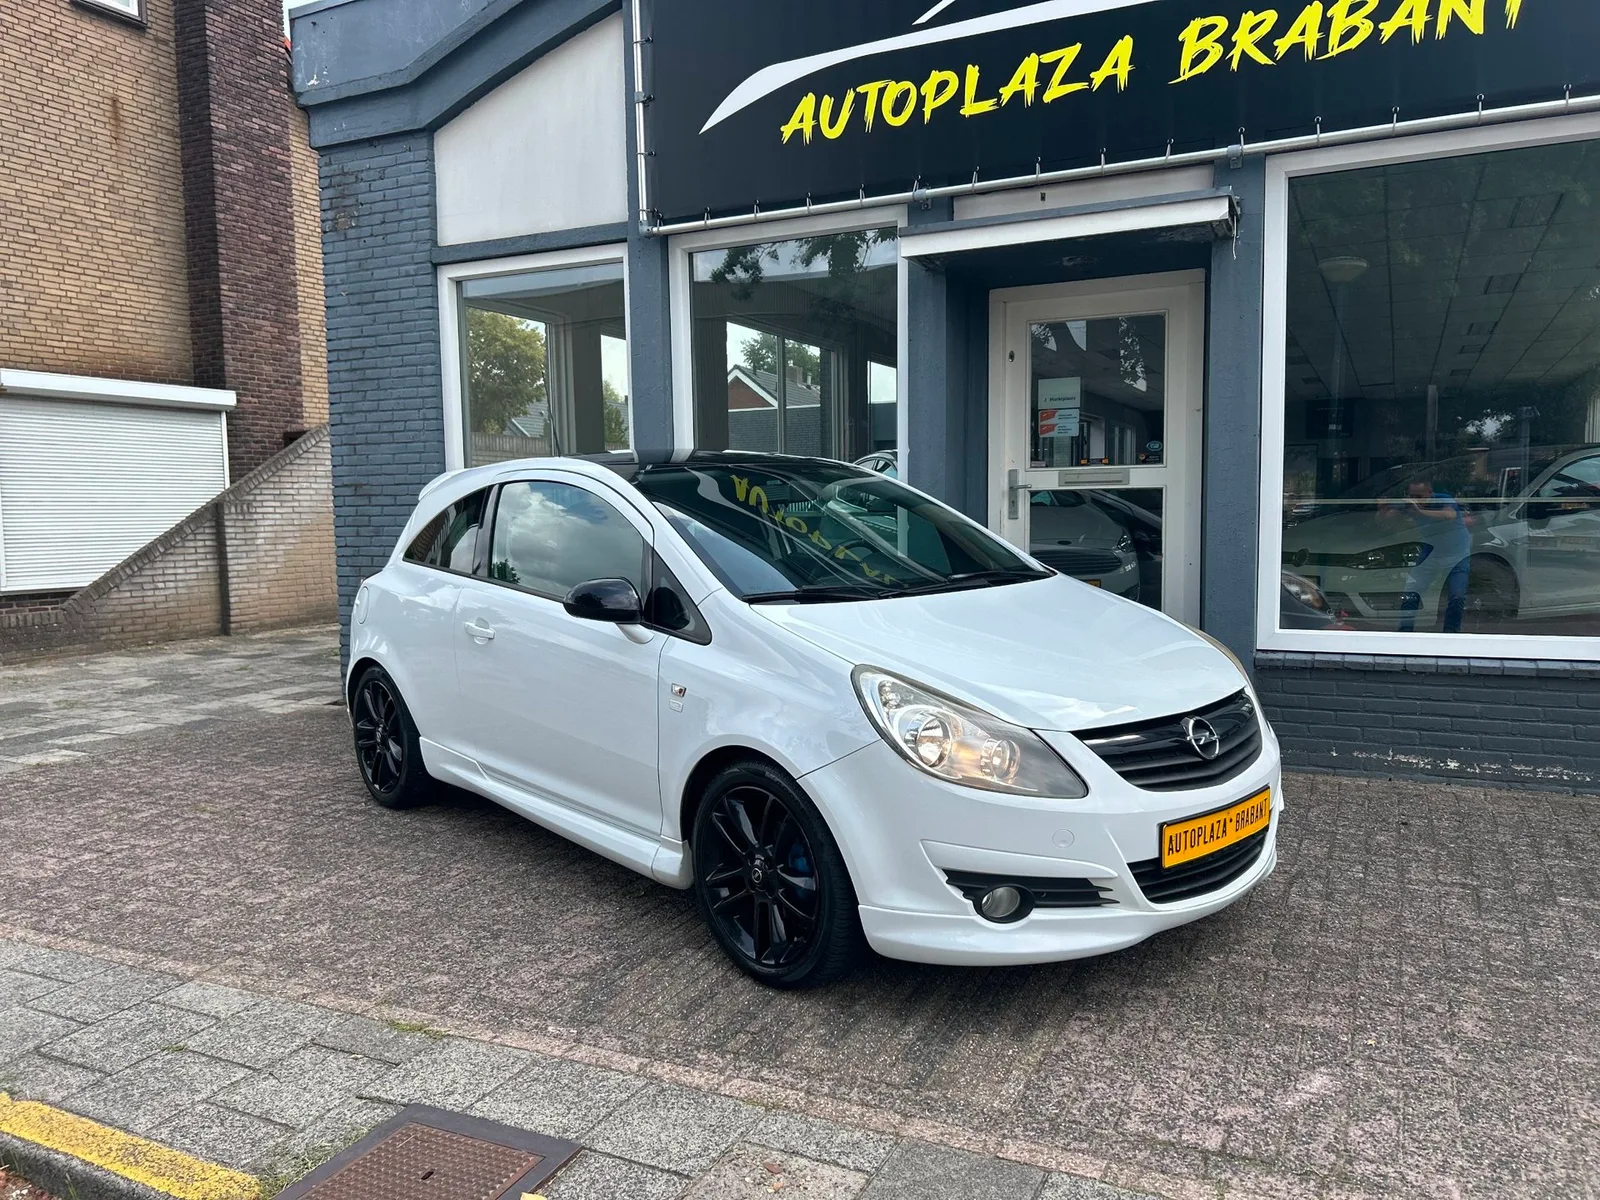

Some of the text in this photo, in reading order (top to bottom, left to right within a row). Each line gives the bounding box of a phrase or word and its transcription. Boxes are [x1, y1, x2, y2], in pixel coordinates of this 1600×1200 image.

[782, 36, 1134, 144] AUTOPLAZA
[1167, 798, 1268, 856] AUTOPLAZA BRABANT
